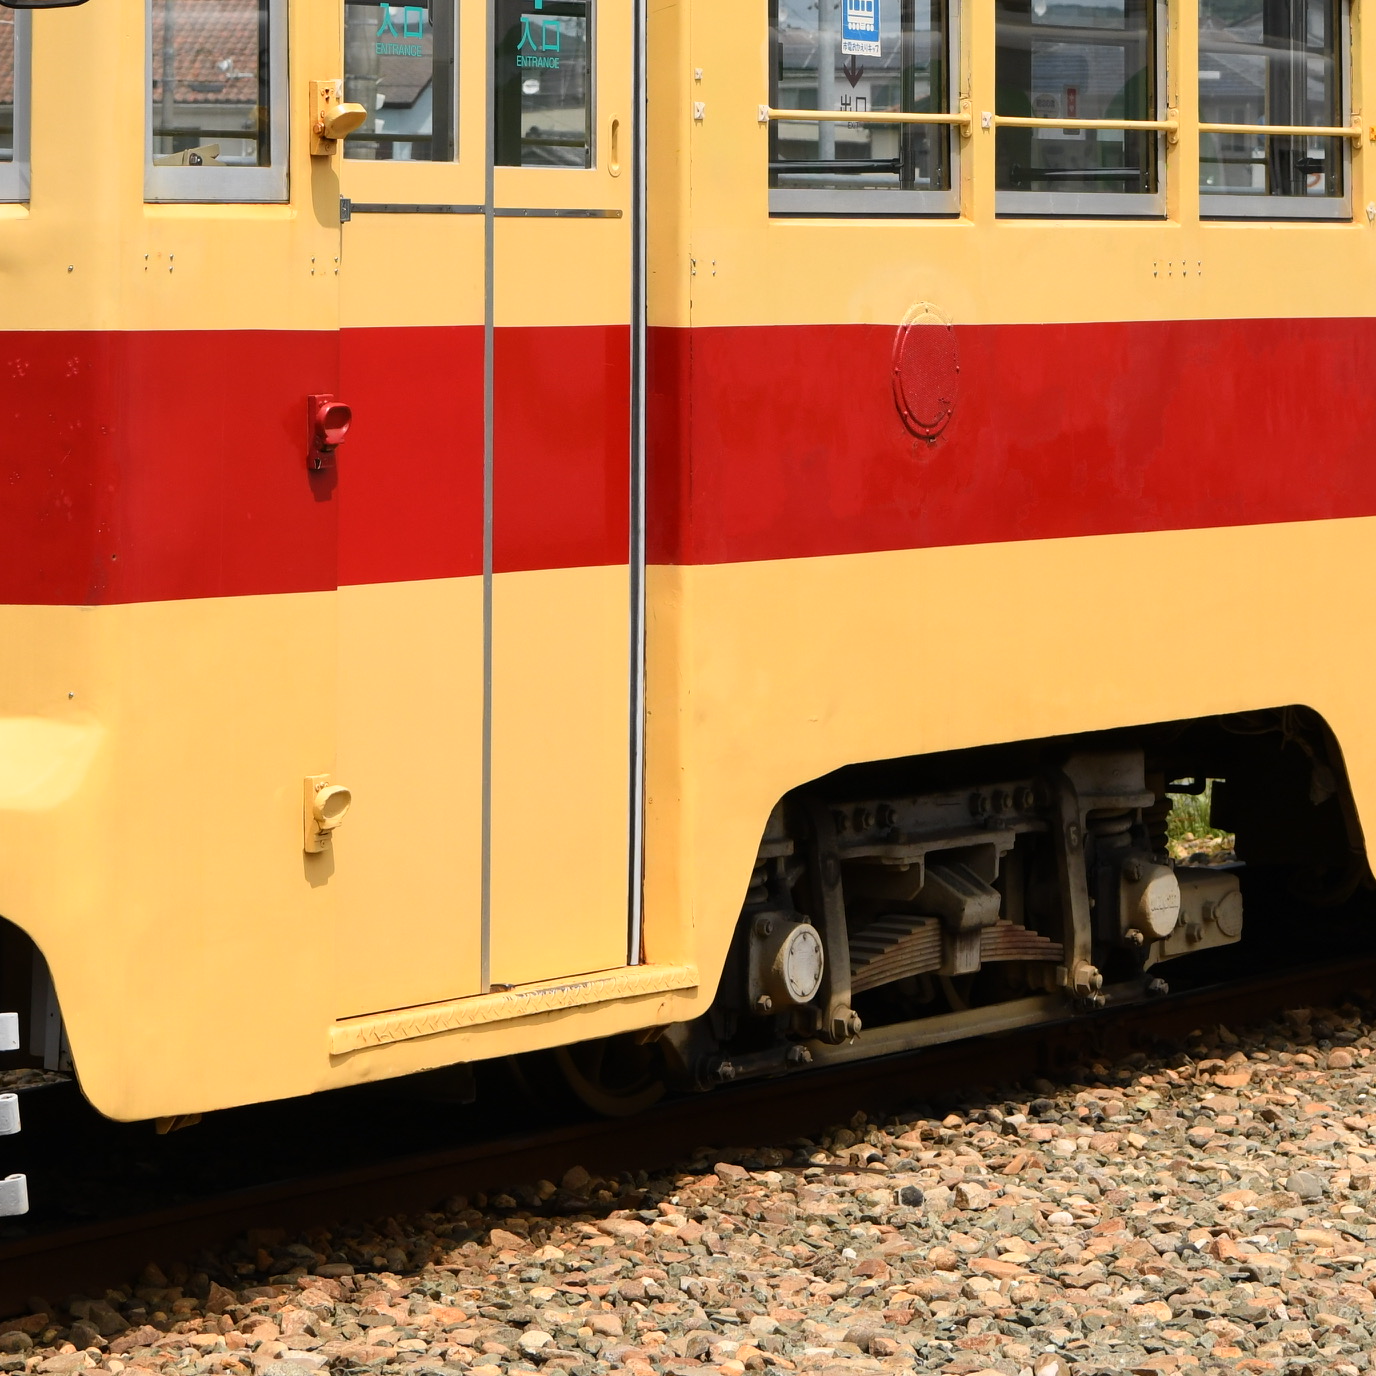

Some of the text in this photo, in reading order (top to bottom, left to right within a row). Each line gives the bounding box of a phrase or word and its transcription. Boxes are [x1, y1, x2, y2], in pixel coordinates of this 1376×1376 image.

[376, 2, 423, 39] 入口
[516, 17, 560, 52] 入口
[376, 43, 422, 57] ENTRANCE
[516, 55, 560, 69] ENTRANCE
